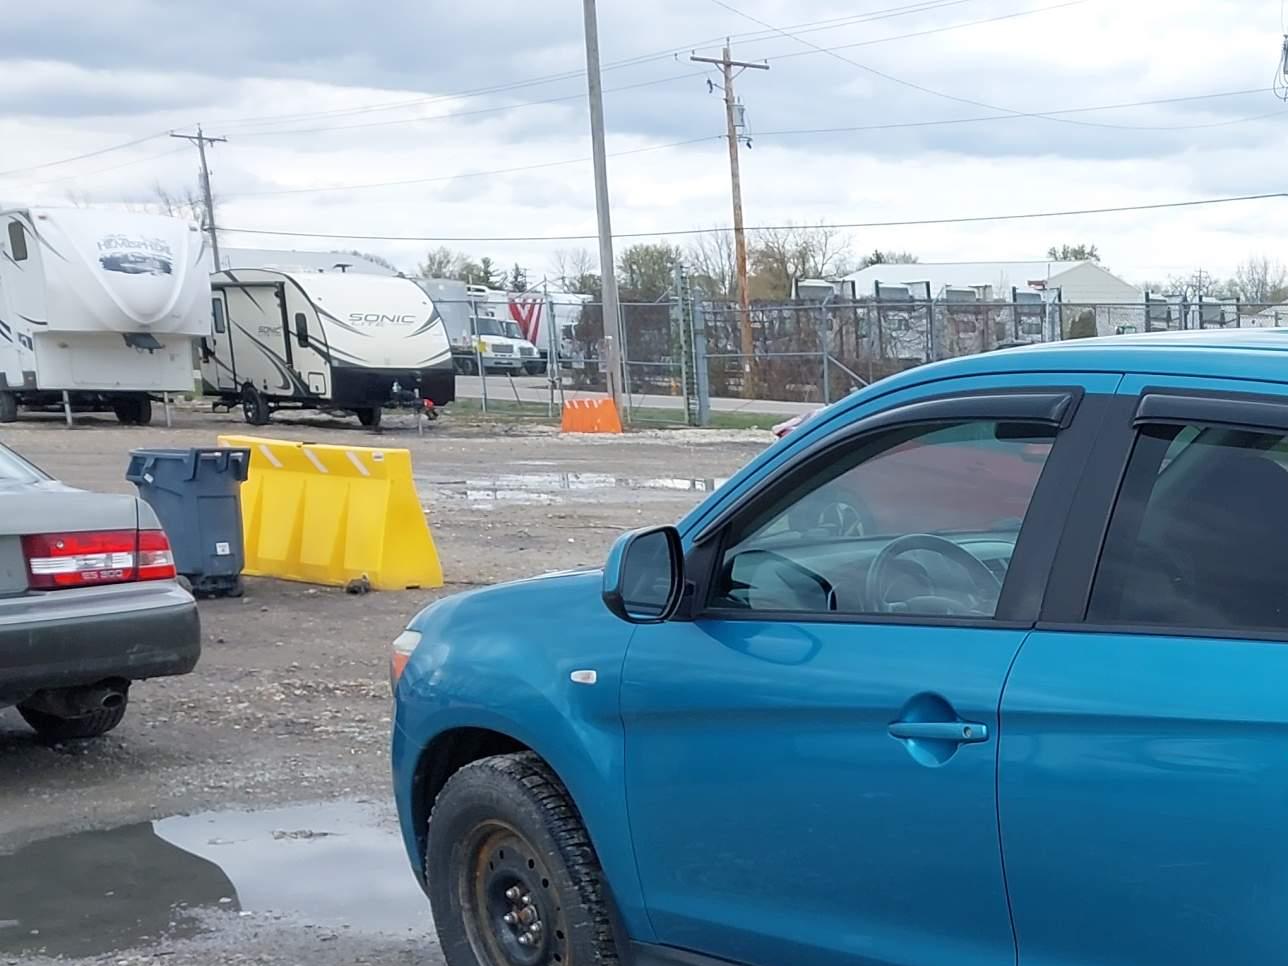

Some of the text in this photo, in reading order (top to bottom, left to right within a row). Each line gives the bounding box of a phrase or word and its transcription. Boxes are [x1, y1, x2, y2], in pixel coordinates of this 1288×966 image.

[349, 313, 416, 323] SONIC
[81, 569, 123, 580] ES 300
